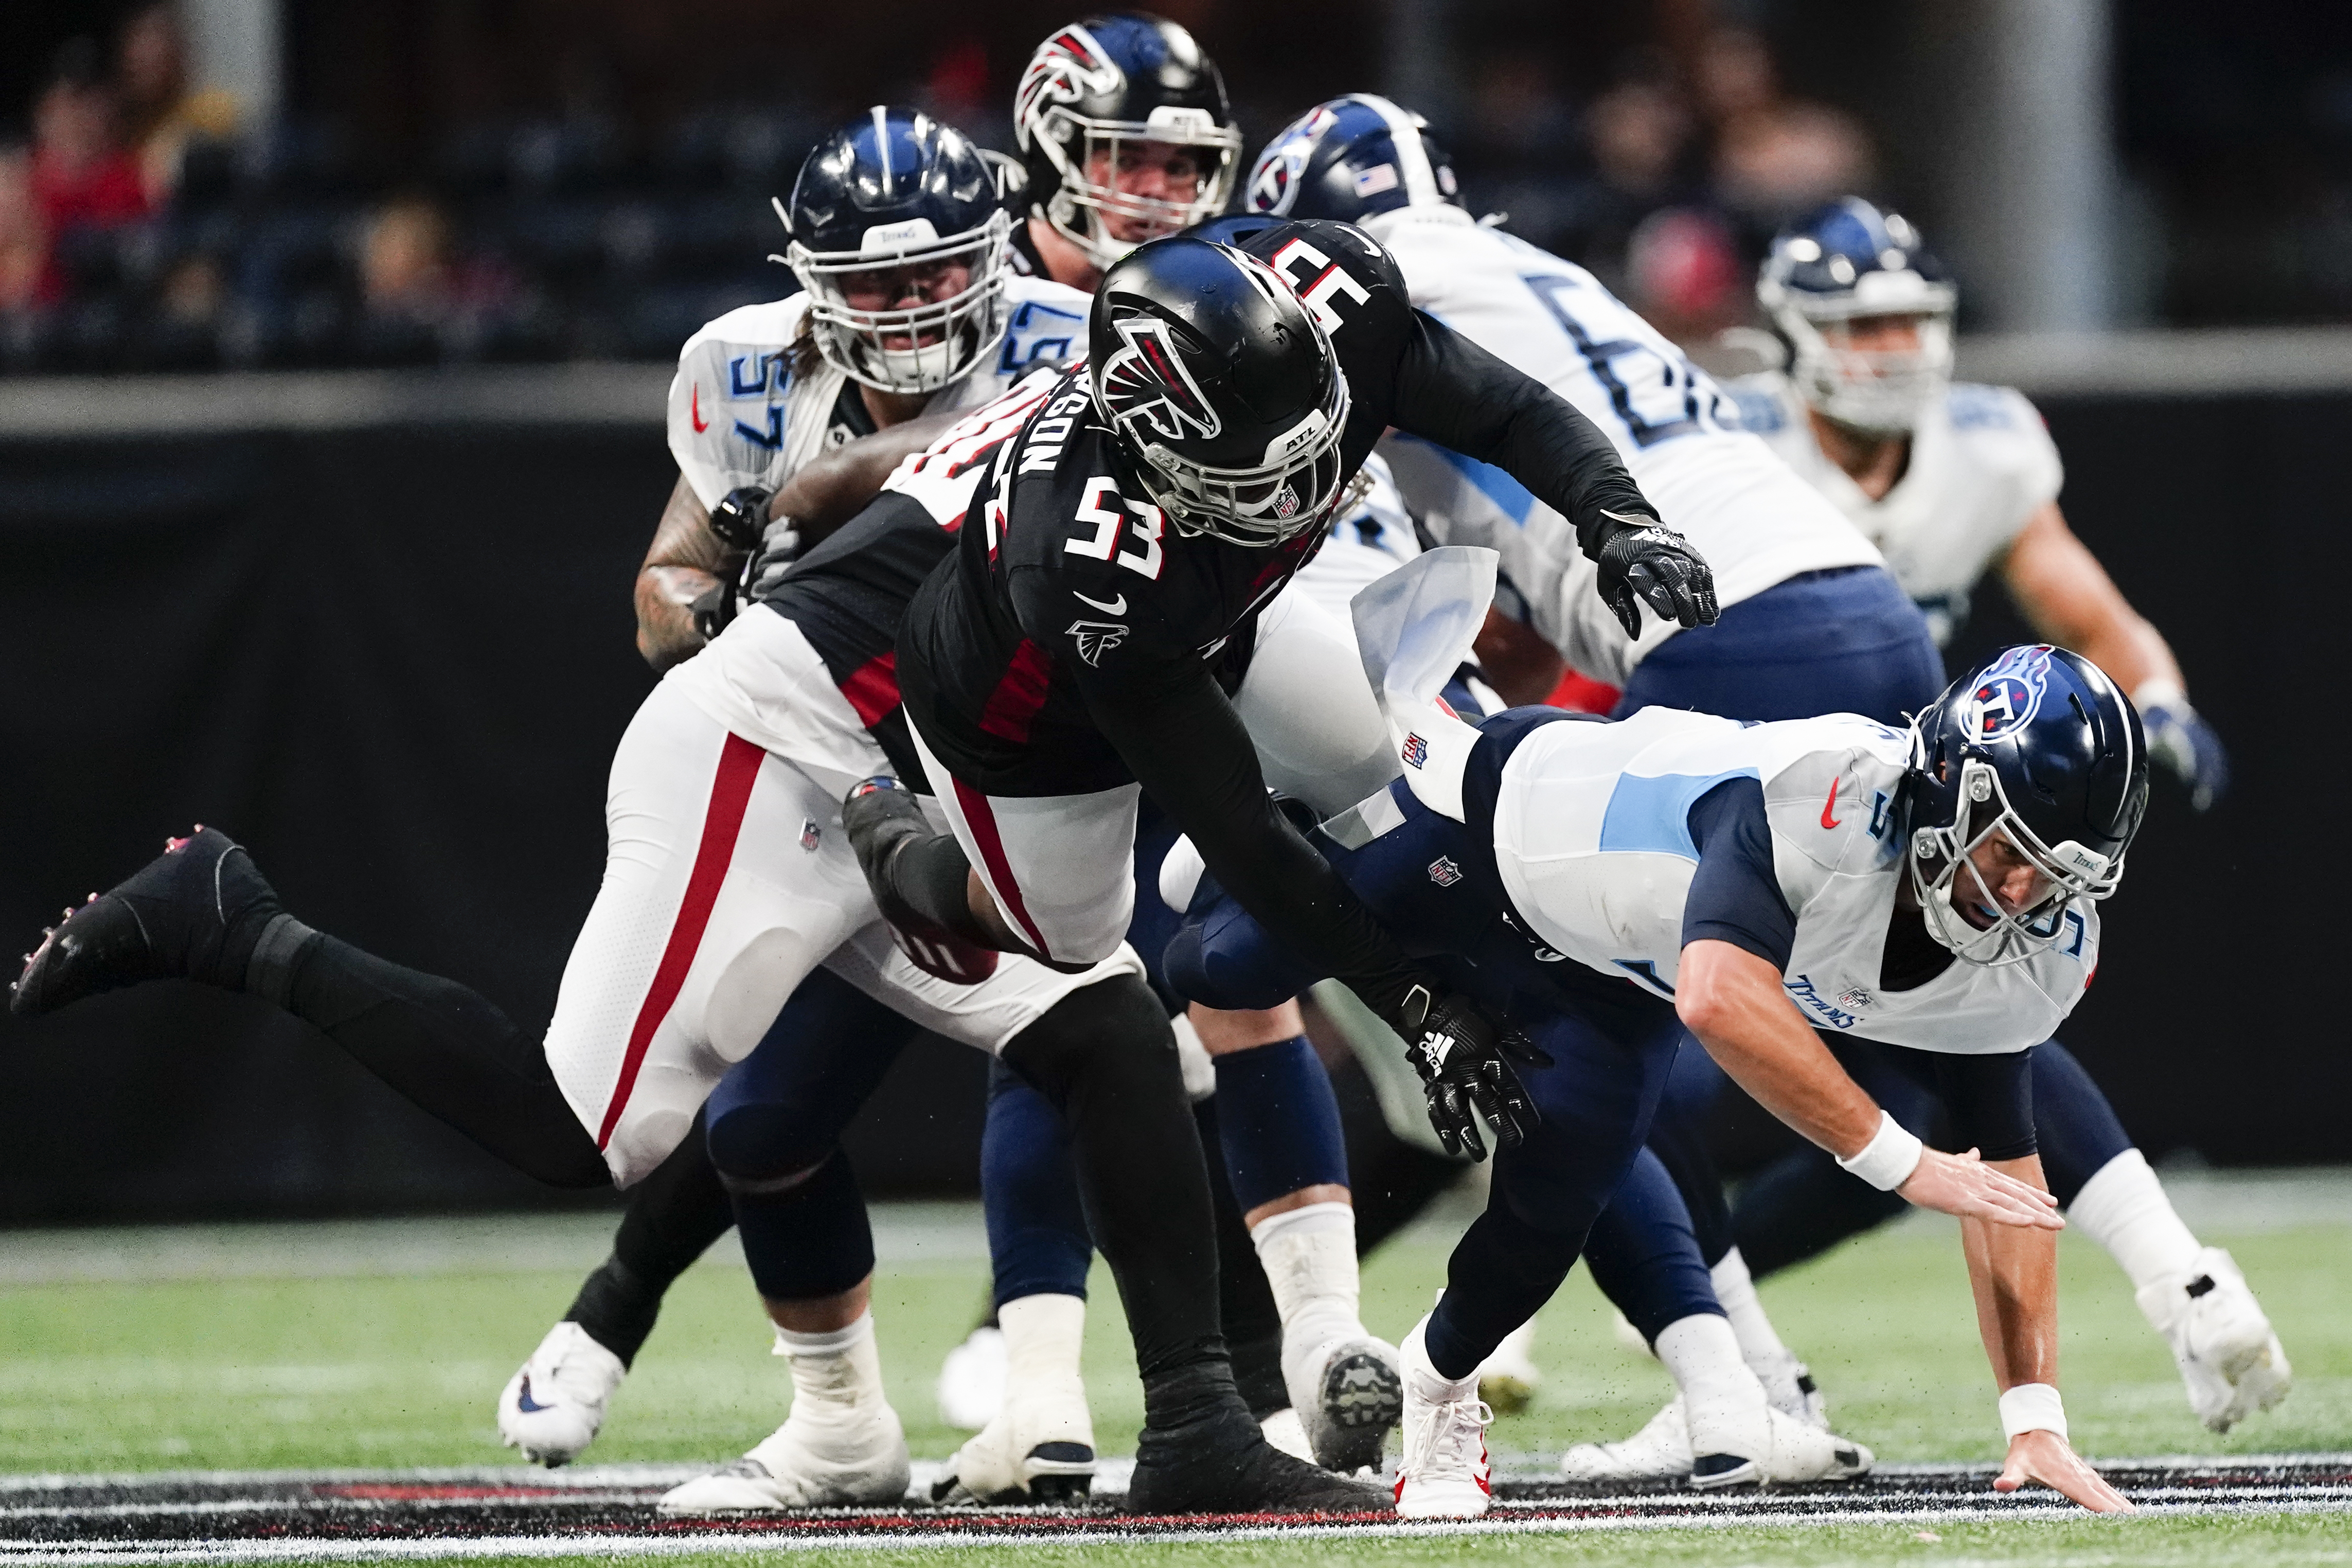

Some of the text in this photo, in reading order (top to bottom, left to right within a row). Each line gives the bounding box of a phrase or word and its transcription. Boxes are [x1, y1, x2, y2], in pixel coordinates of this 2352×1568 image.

[728, 351, 798, 450] 57
[1286, 426, 1316, 452] ATL
[1279, 498, 1297, 518] NFL
[1064, 476, 1166, 581] 53
[1403, 734, 1418, 760] NFL
[1432, 863, 1451, 883] NFL
[1841, 993, 1861, 1009] NFL
[1418, 1041, 1442, 1078] adidas
